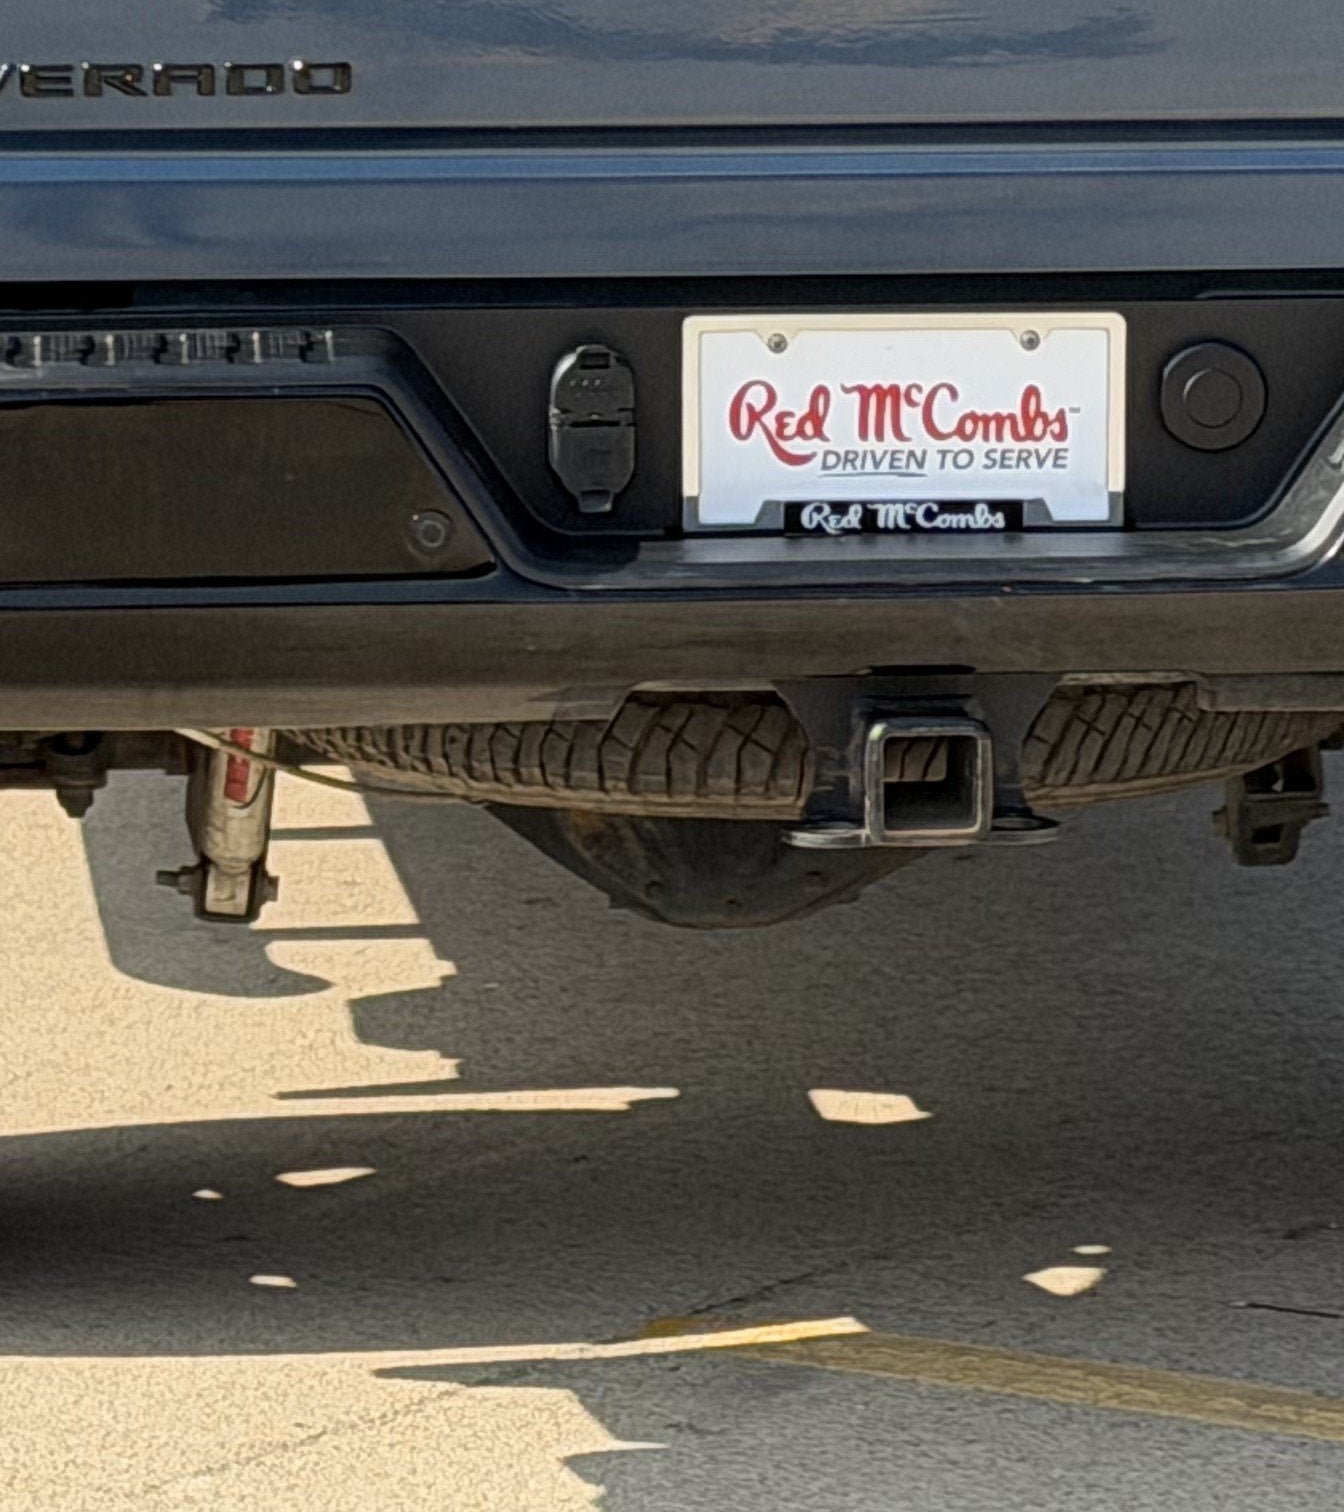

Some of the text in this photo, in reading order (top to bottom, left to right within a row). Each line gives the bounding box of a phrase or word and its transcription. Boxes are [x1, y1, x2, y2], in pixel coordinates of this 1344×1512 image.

[729, 379, 831, 466] Red
[820, 447, 1069, 471] DRIVEN TO SERVE
[800, 501, 863, 530] Red
